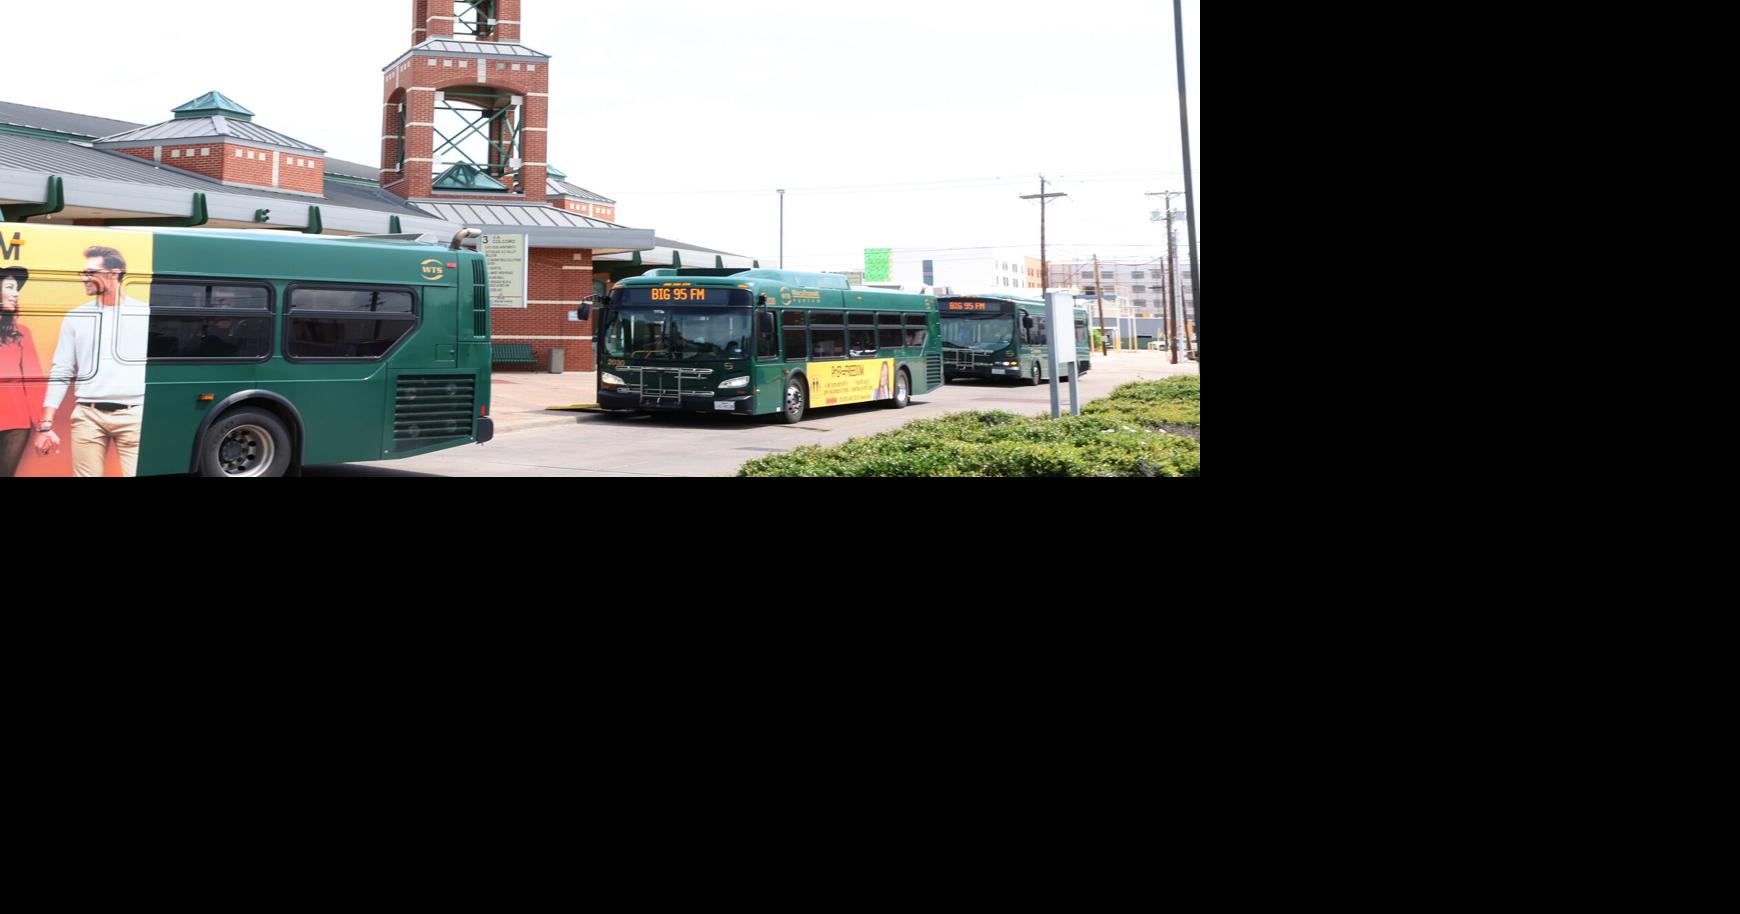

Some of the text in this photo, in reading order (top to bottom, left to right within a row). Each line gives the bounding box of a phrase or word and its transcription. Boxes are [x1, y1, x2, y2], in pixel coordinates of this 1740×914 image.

[482, 236, 489, 244] 3
[0, 231, 20, 260] M
[422, 266, 443, 274] WTS
[651, 288, 705, 300] BIG 95 FM
[949, 302, 986, 310] BIG 95 FM
